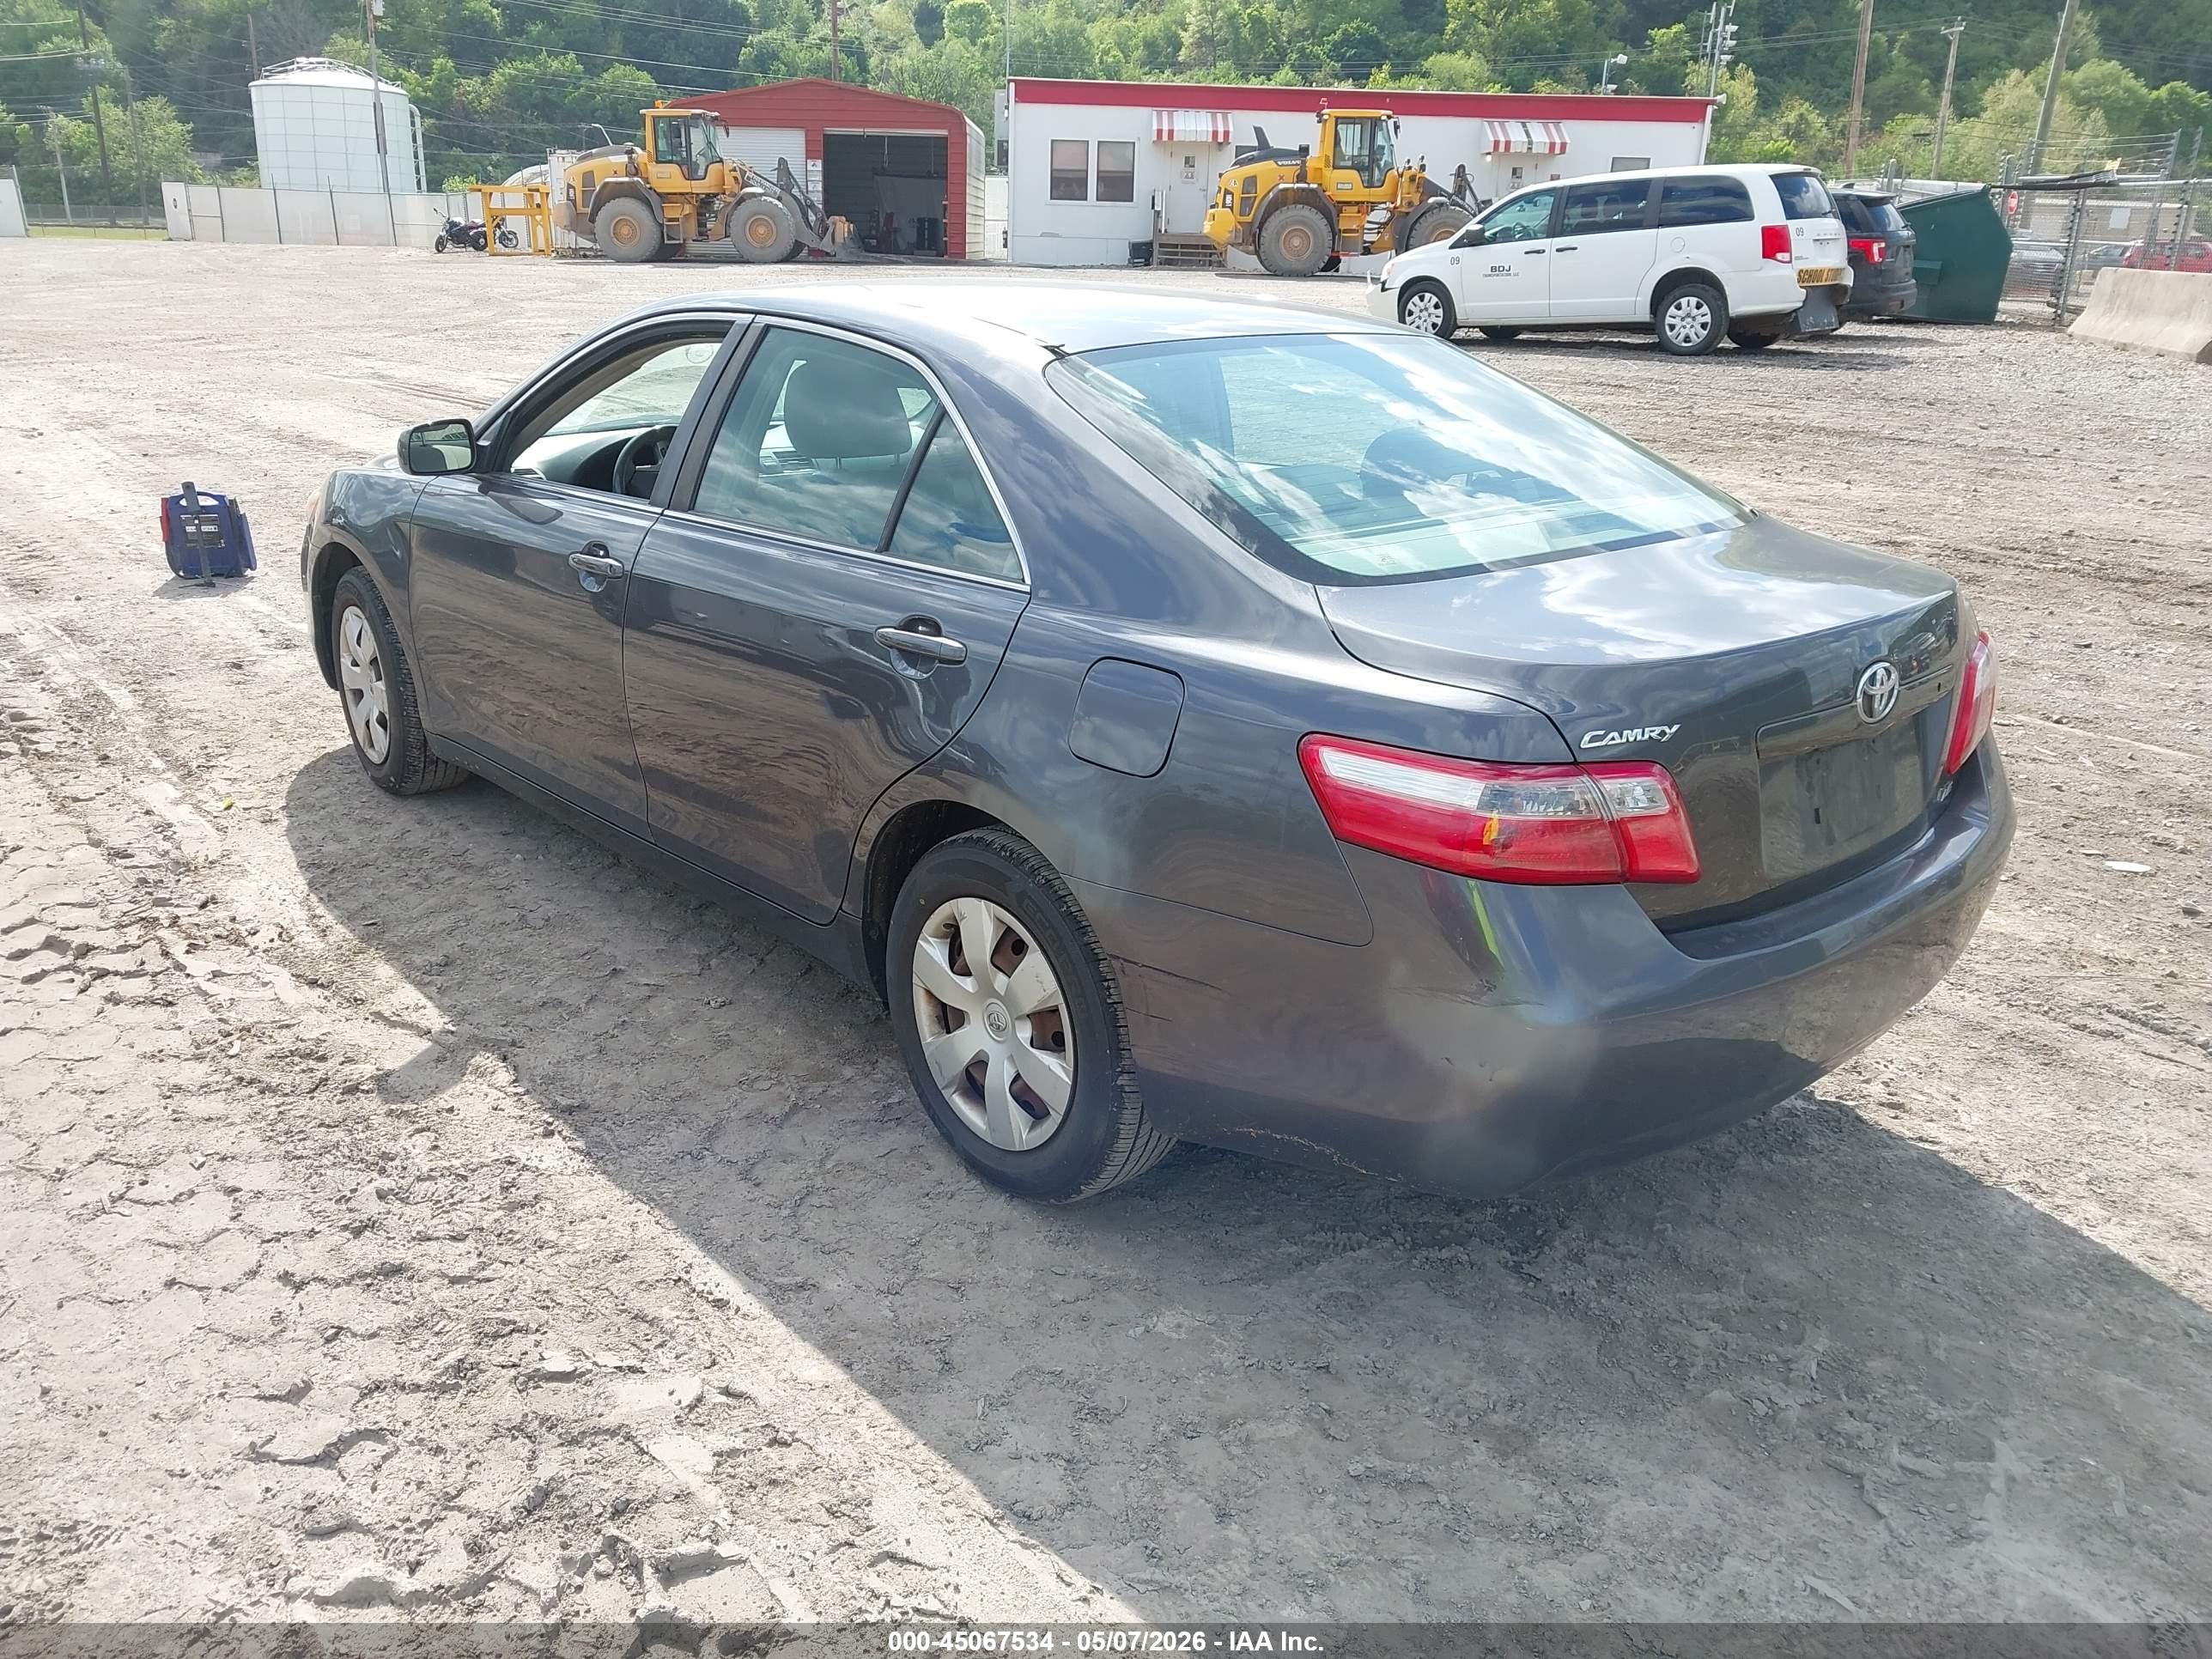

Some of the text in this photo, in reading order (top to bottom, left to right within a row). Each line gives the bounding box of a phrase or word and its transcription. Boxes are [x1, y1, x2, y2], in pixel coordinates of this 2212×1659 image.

[1796, 227, 1804, 237] 09
[1449, 256, 1461, 265] 09
[1796, 269, 1825, 284] SCHOOL
[1580, 724, 1681, 749] CAMRY
